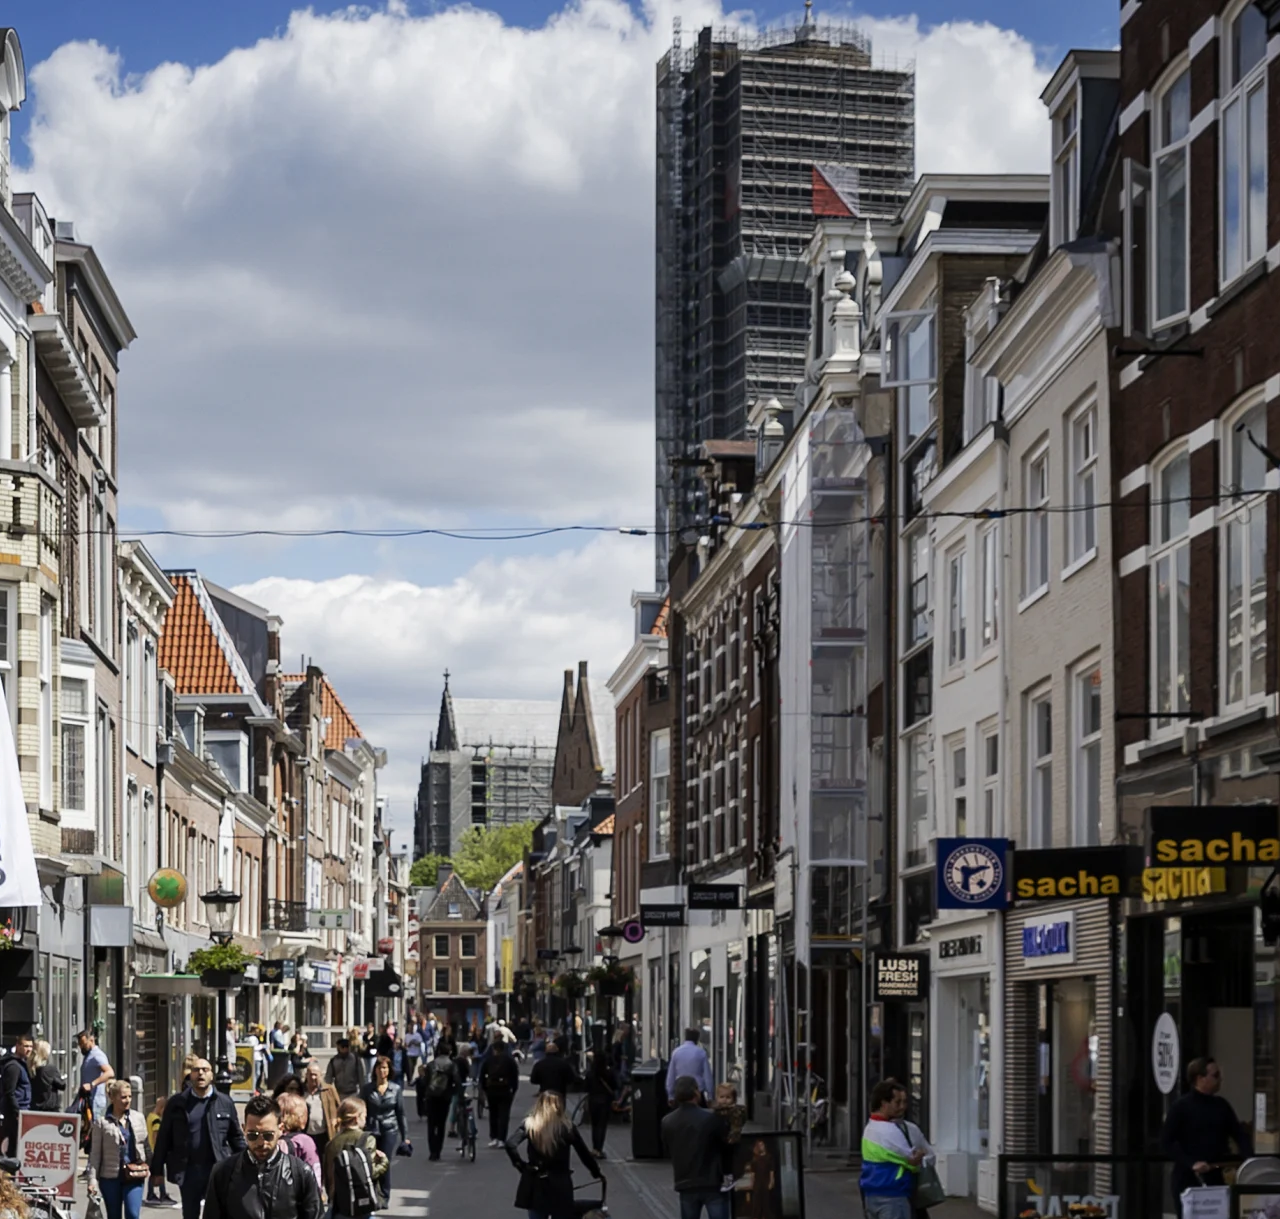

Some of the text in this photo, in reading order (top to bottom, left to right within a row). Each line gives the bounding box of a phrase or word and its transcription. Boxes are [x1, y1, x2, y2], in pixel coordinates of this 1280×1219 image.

[1156, 831, 1280, 863] sacha
[1017, 869, 1120, 898] sacha
[878, 959, 919, 971] LUSH
[878, 971, 919, 981] FRESH
[60, 1123, 74, 1134] JD
[25, 1141, 71, 1151] BIGGEST
[25, 1150, 70, 1164] SALE
